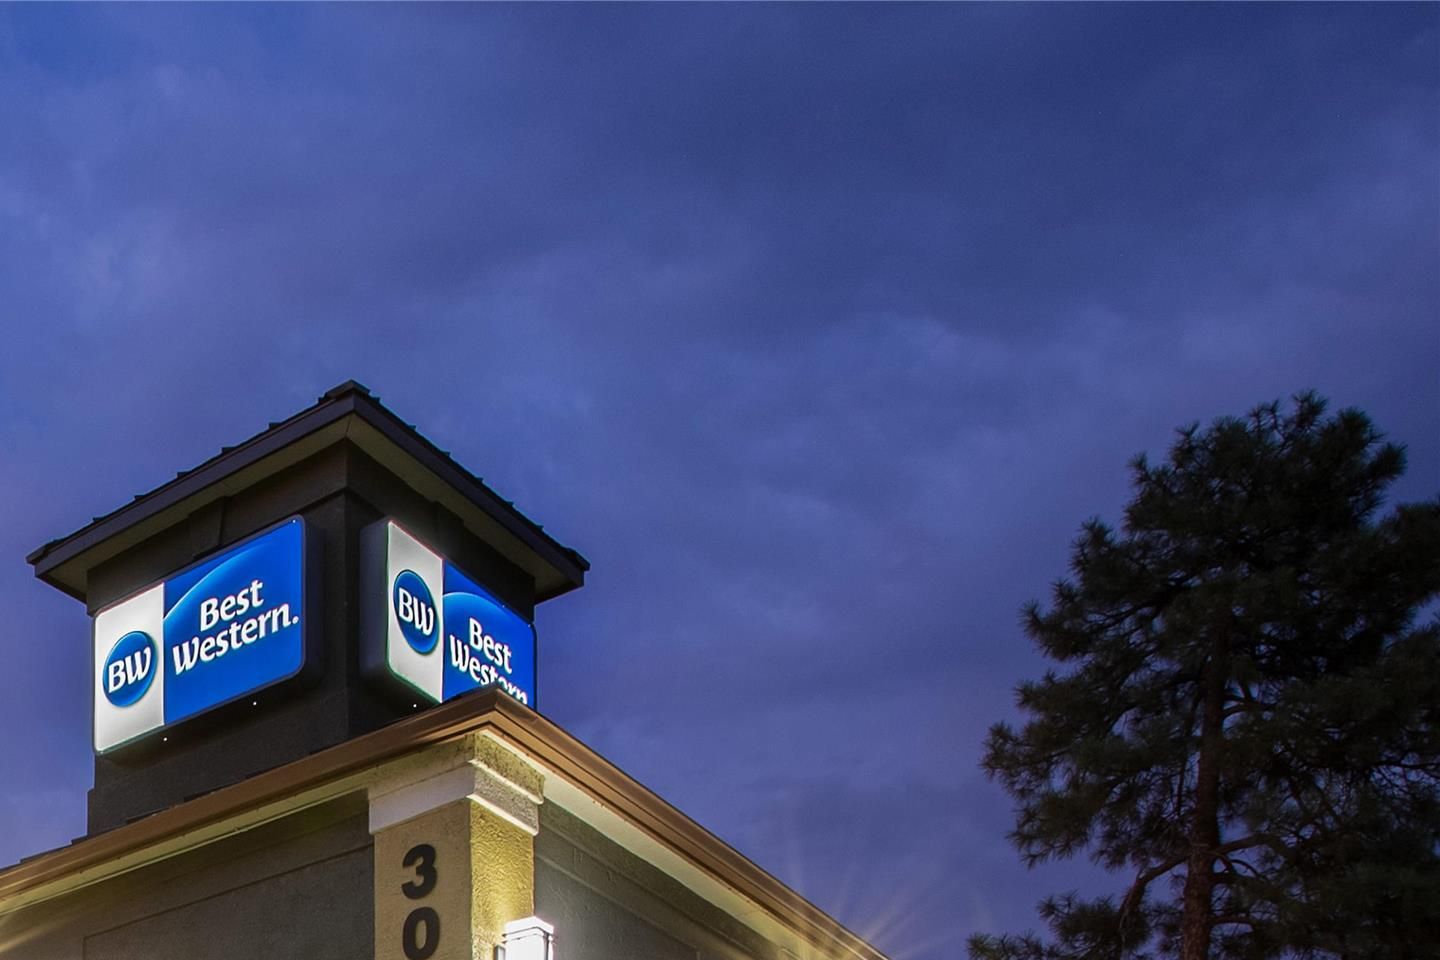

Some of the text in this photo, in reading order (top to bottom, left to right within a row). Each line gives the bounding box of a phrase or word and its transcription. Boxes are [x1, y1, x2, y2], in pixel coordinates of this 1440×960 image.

[200, 579, 265, 632] Best
[398, 586, 435, 636] BW
[108, 647, 152, 694] BW
[469, 617, 513, 675] Best
